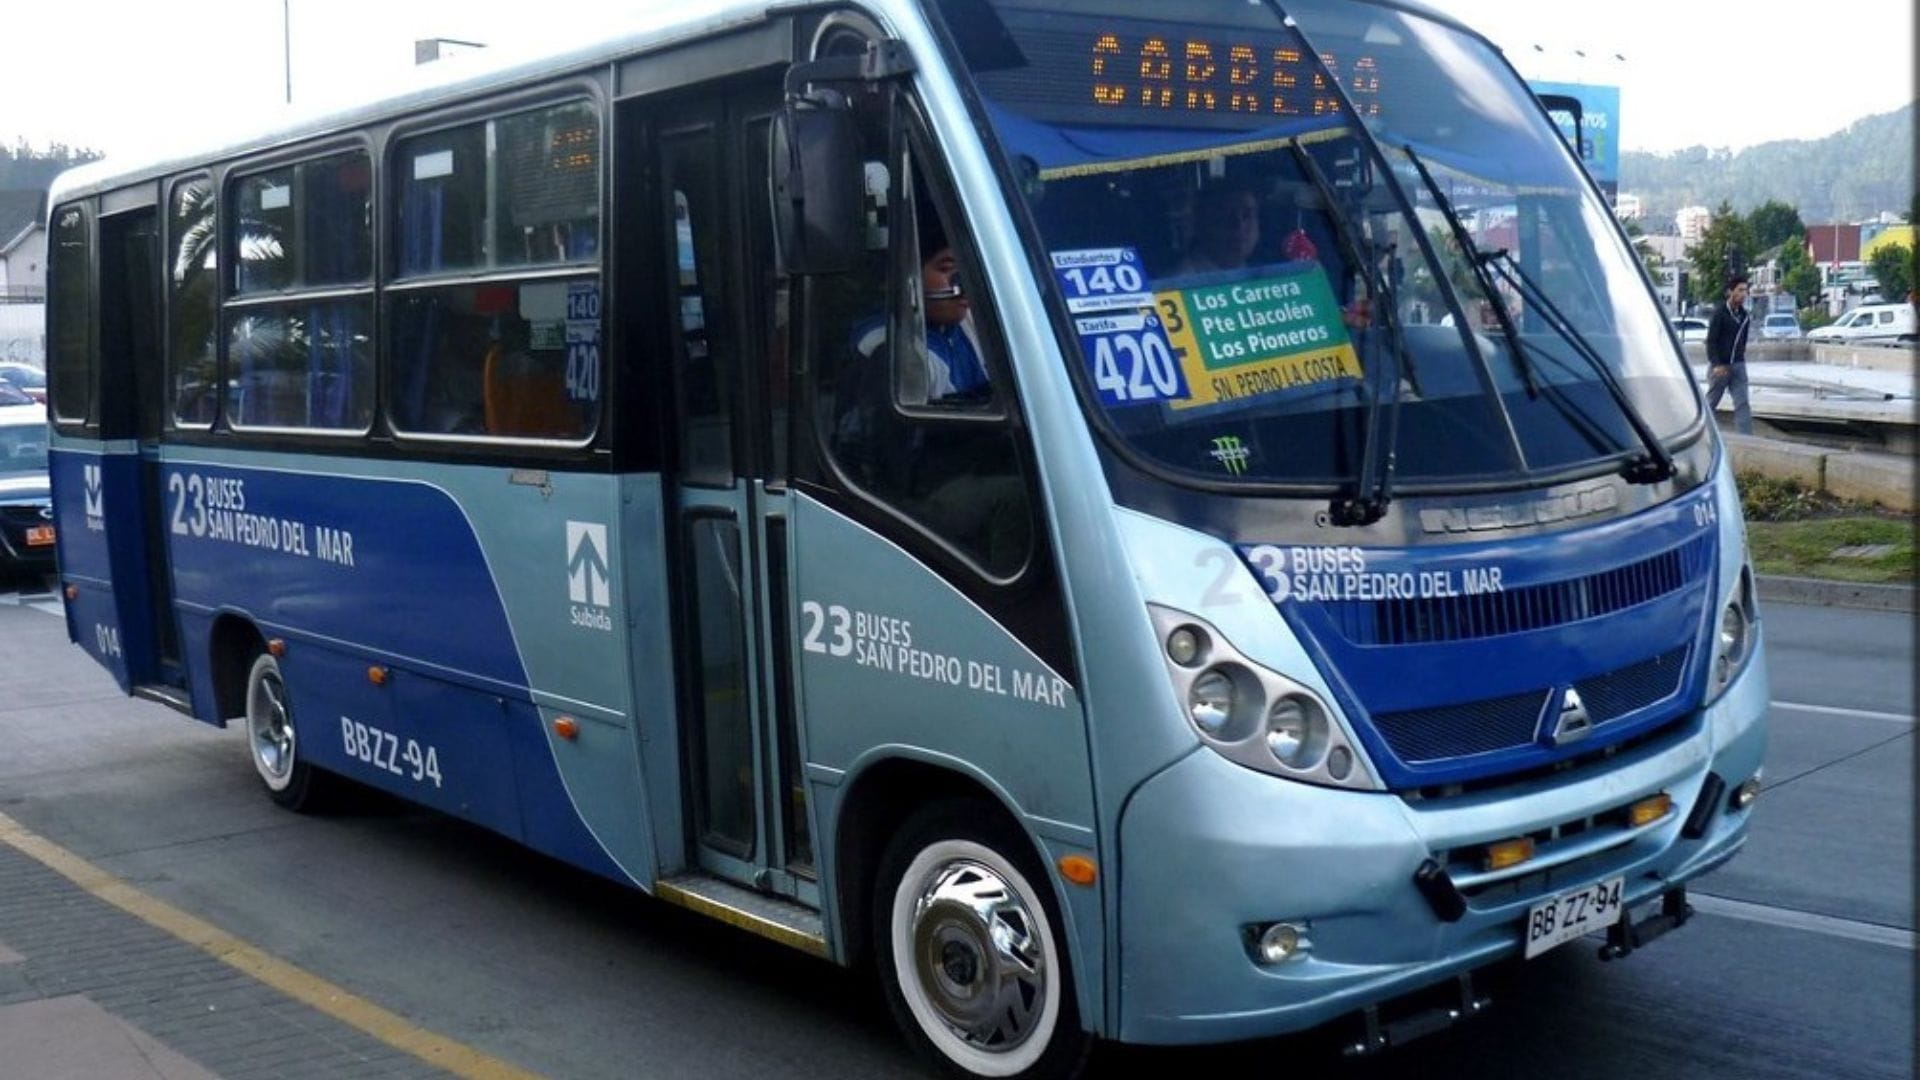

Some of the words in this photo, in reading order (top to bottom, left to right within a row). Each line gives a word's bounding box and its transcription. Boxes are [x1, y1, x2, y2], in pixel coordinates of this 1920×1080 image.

[1092, 34, 1380, 115] CARRERA
[1064, 265, 1142, 295] 140
[1193, 293, 1228, 311] Los
[1231, 282, 1301, 305] Carrera
[568, 294, 599, 319] 140
[1081, 318, 1117, 332] Tarifa
[1202, 316, 1236, 336] Pte
[1238, 301, 1315, 329] Llacolén
[1209, 341, 1245, 360] Los
[1247, 325, 1329, 353] Pioneros
[566, 344, 600, 402] 420
[1095, 332, 1178, 400] 420
[1237, 366, 1283, 397] PEDRO
[1282, 363, 1304, 389] LA
[1303, 355, 1348, 384] COSTA
[169, 472, 206, 537] 23
[206, 477, 245, 511] BUSES
[208, 509, 234, 542] SAN
[236, 514, 279, 550] PEDRO
[283, 520, 309, 556] DEL
[316, 525, 354, 566] MAR
[1193, 545, 1290, 607] 23
[1292, 547, 1365, 574] BUSES
[1293, 574, 1345, 602] SAN
[1348, 572, 1416, 601] PEDRO
[1420, 571, 1458, 599] DEL
[1462, 566, 1504, 594] MAR
[570, 605, 611, 631] Subida
[802, 600, 852, 657] 23
[856, 611, 912, 648] BUSES
[96, 623, 122, 659] 014
[856, 639, 893, 672] SAN
[898, 648, 962, 685] PEDRO
[968, 661, 1007, 695] DEL
[1012, 669, 1066, 708] MAR
[341, 715, 442, 788] BBZZ-94
[1532, 904, 1557, 941] BB
